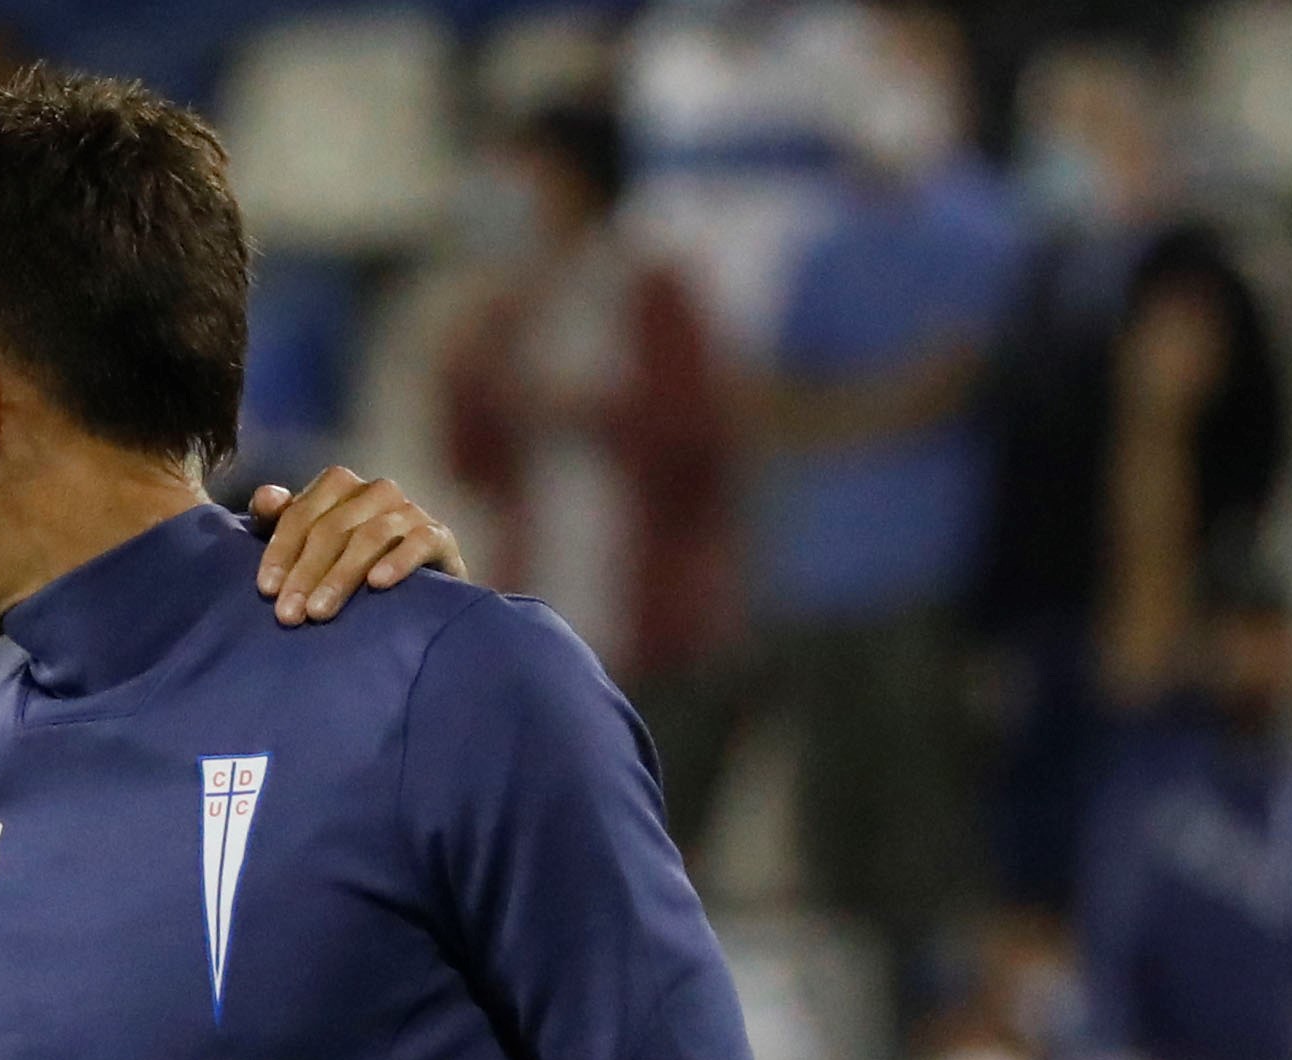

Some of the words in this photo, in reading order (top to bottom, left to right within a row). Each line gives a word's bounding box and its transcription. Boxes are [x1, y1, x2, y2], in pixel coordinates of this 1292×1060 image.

[213, 771, 226, 787] C
[239, 770, 252, 786] D
[209, 801, 222, 817] U
[236, 800, 249, 815] C
